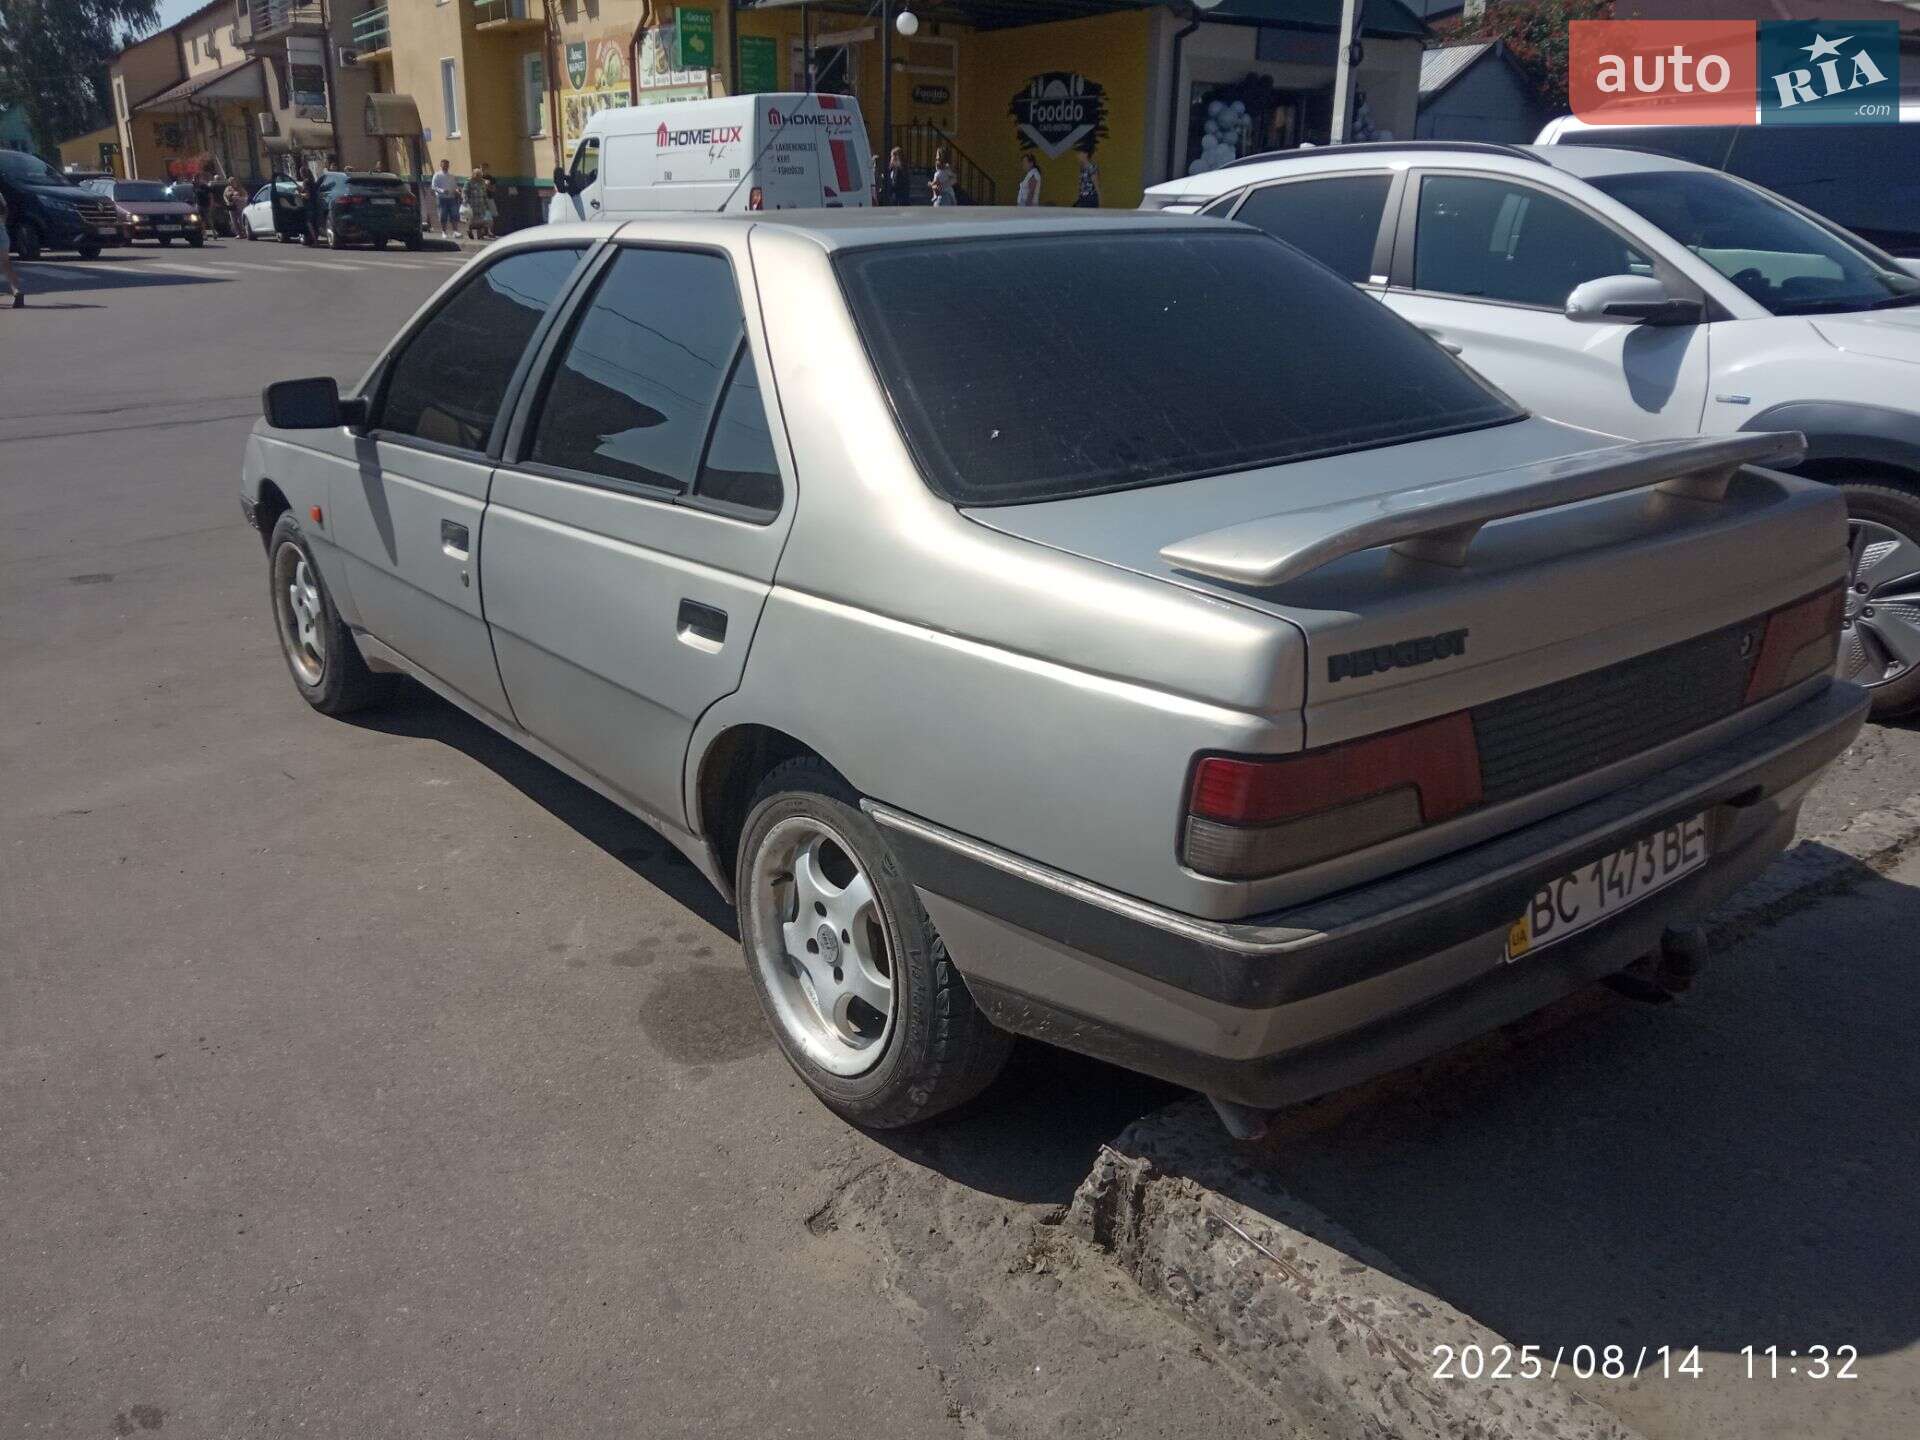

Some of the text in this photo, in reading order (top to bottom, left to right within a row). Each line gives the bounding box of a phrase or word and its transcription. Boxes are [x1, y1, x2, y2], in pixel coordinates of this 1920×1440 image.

[782, 113, 852, 126] HOMELUX
[1029, 99, 1084, 122] Fooddo
[667, 126, 742, 147] HOMELUX
[1328, 628, 1469, 683] PEUGEOT
[1531, 875, 1580, 938] BC
[1590, 834, 1656, 908] 1473
